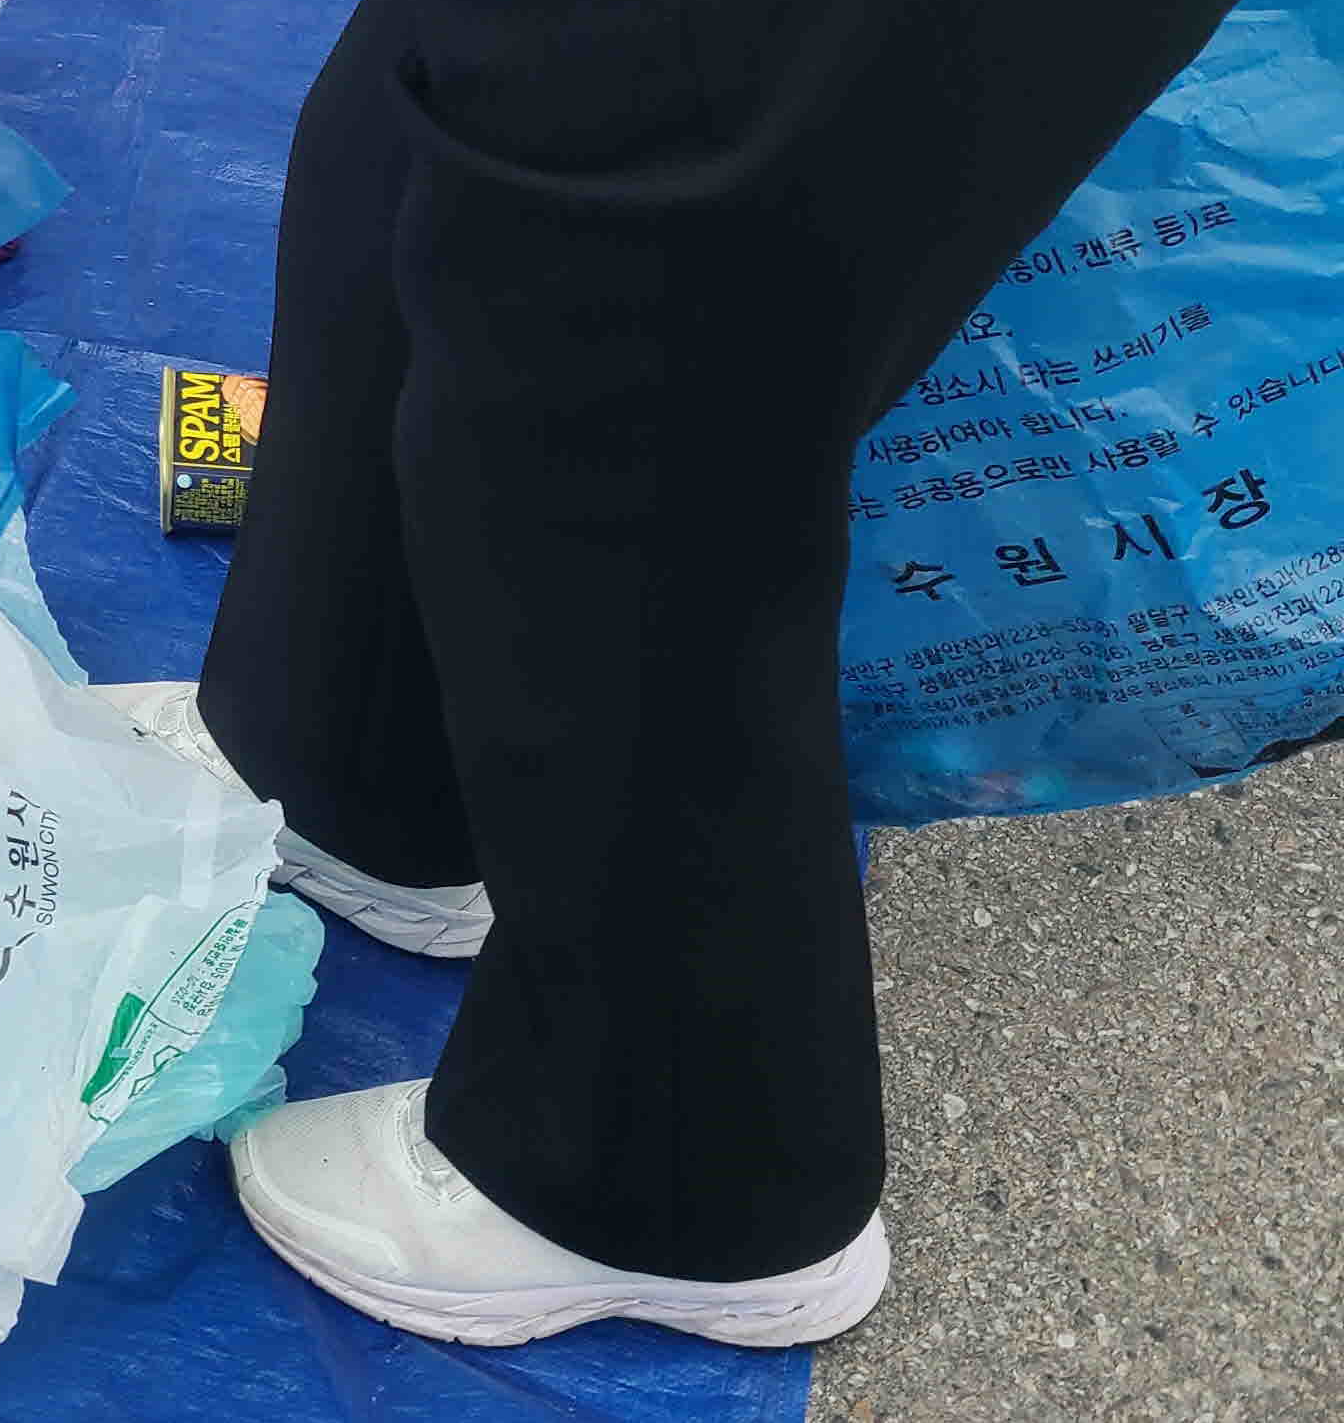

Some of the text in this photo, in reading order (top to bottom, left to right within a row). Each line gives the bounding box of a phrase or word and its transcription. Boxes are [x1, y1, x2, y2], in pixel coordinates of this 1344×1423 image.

[1092, 303, 1213, 375] 쓰레기를
[179, 372, 221, 462] SPAM
[868, 397, 1130, 466] 사용하여야 합니다.
[893, 454, 1077, 511] 공공용으로만
[1088, 426, 1182, 472] 사용할
[1192, 411, 1220, 439] 수
[36, 848, 61, 927] SUWON
